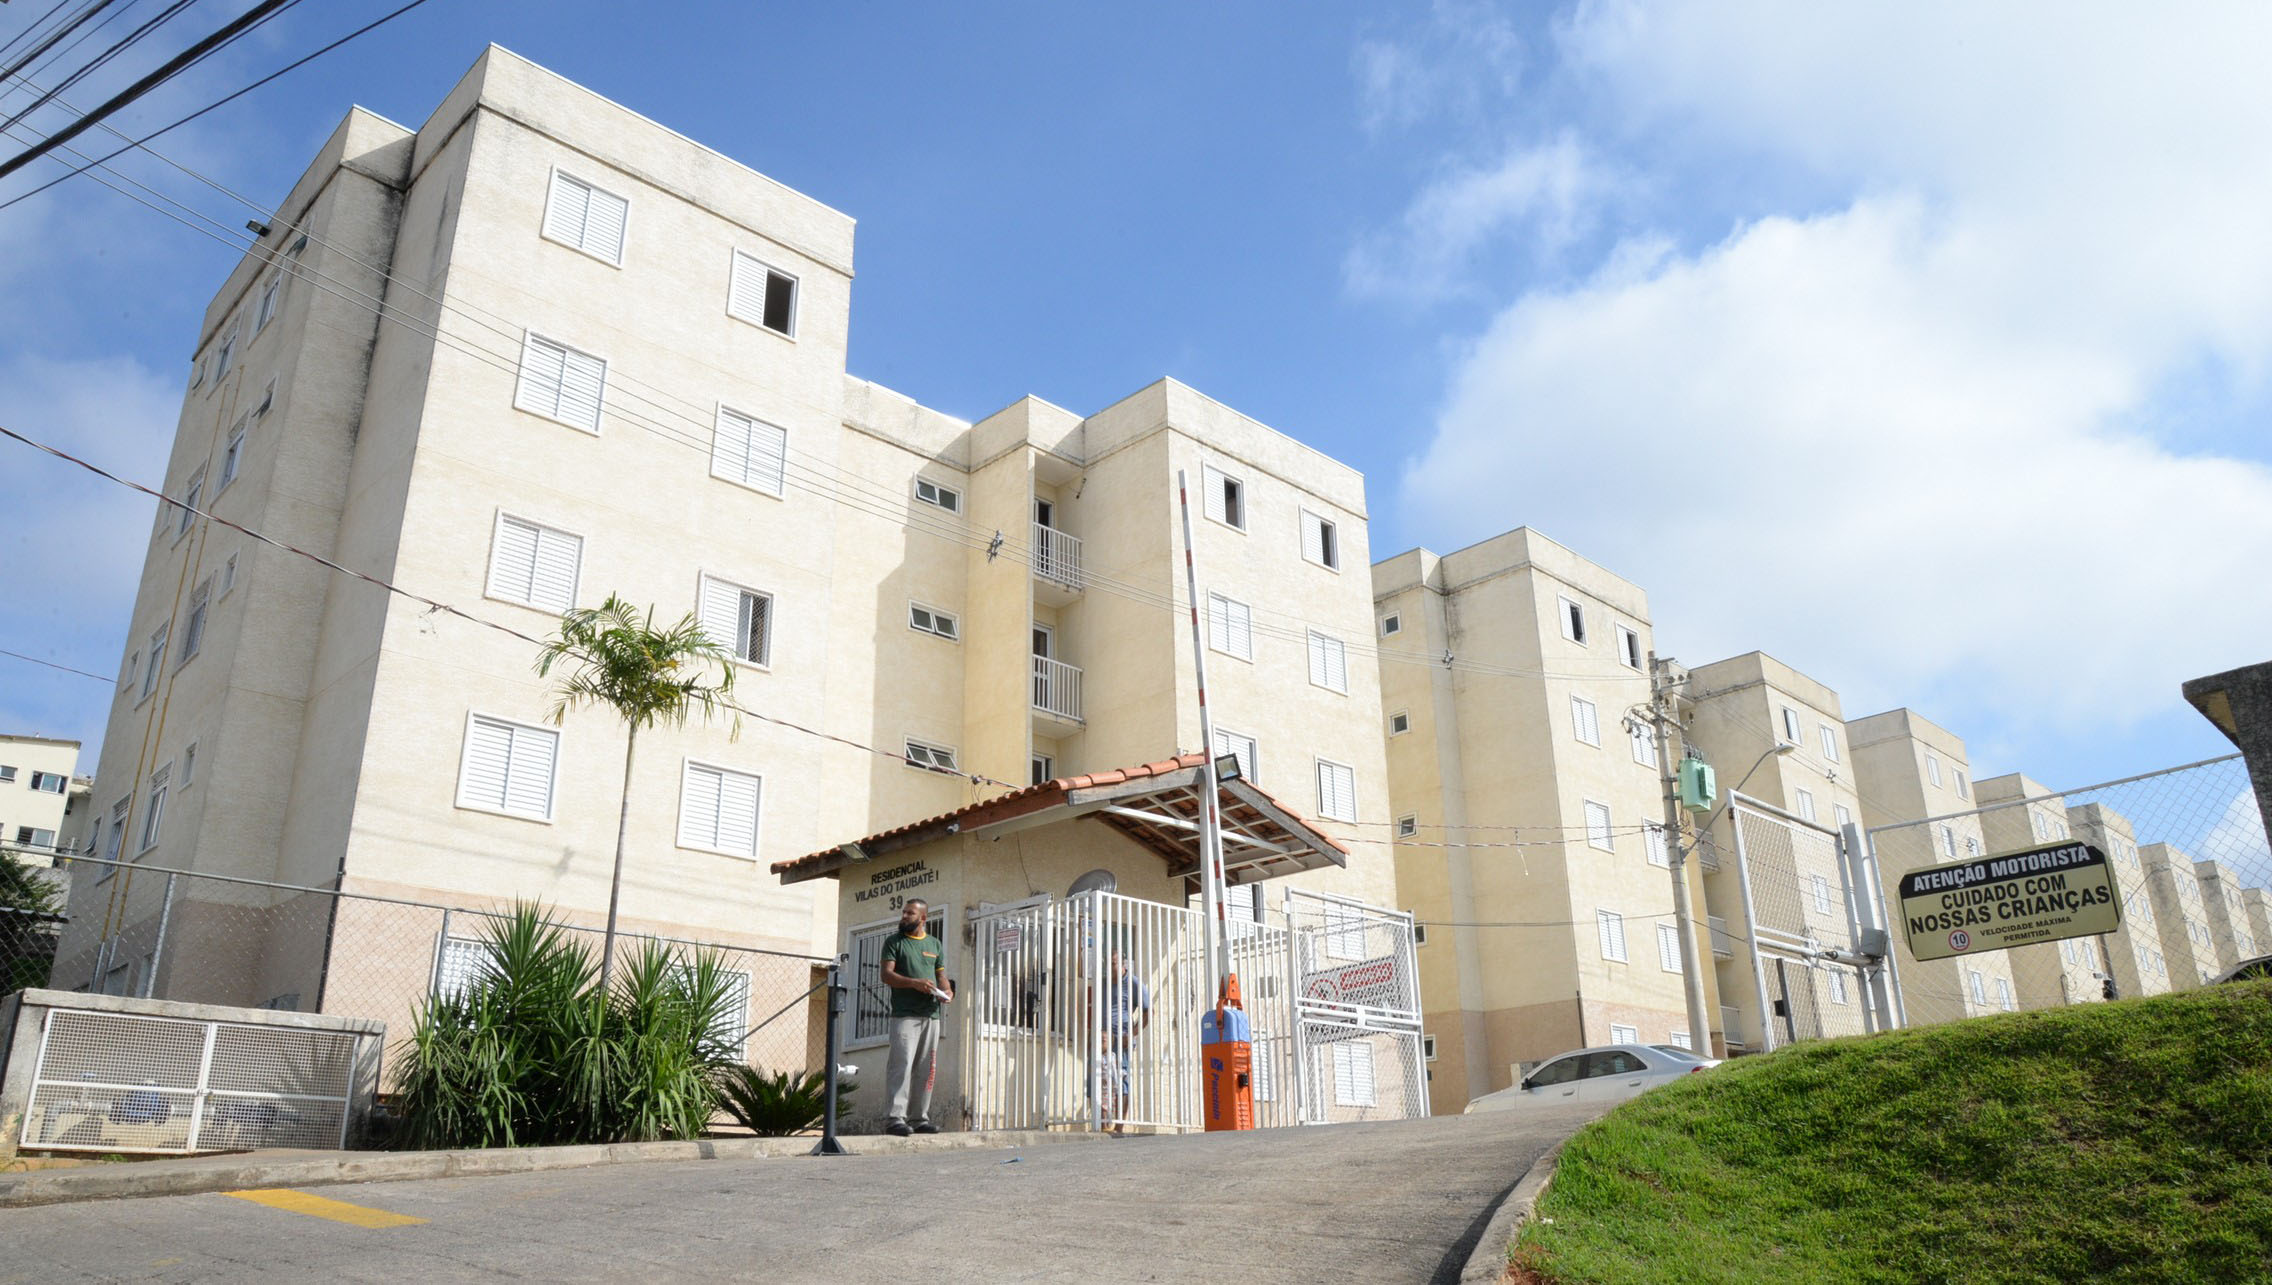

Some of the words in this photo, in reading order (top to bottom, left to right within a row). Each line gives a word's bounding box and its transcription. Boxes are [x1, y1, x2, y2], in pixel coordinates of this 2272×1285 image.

[871, 860, 927, 885] RESIDENCIAL
[1913, 864, 1986, 892] ATENÇÃO
[1991, 846, 2091, 878] MOTORISTA
[855, 887, 879, 902] VILAS
[880, 883, 893, 896] DO
[1941, 882, 2020, 910] CUIDADO
[2025, 873, 2067, 895] COM
[889, 895, 904, 911] 39
[1910, 905, 1991, 935] NOSSAS
[1997, 885, 2111, 920] CRIANÇAS
[1980, 922, 2033, 937] VELOCIDADE
[2003, 929, 2051, 942] PERMITIDA
[1952, 934, 1966, 945] 10
